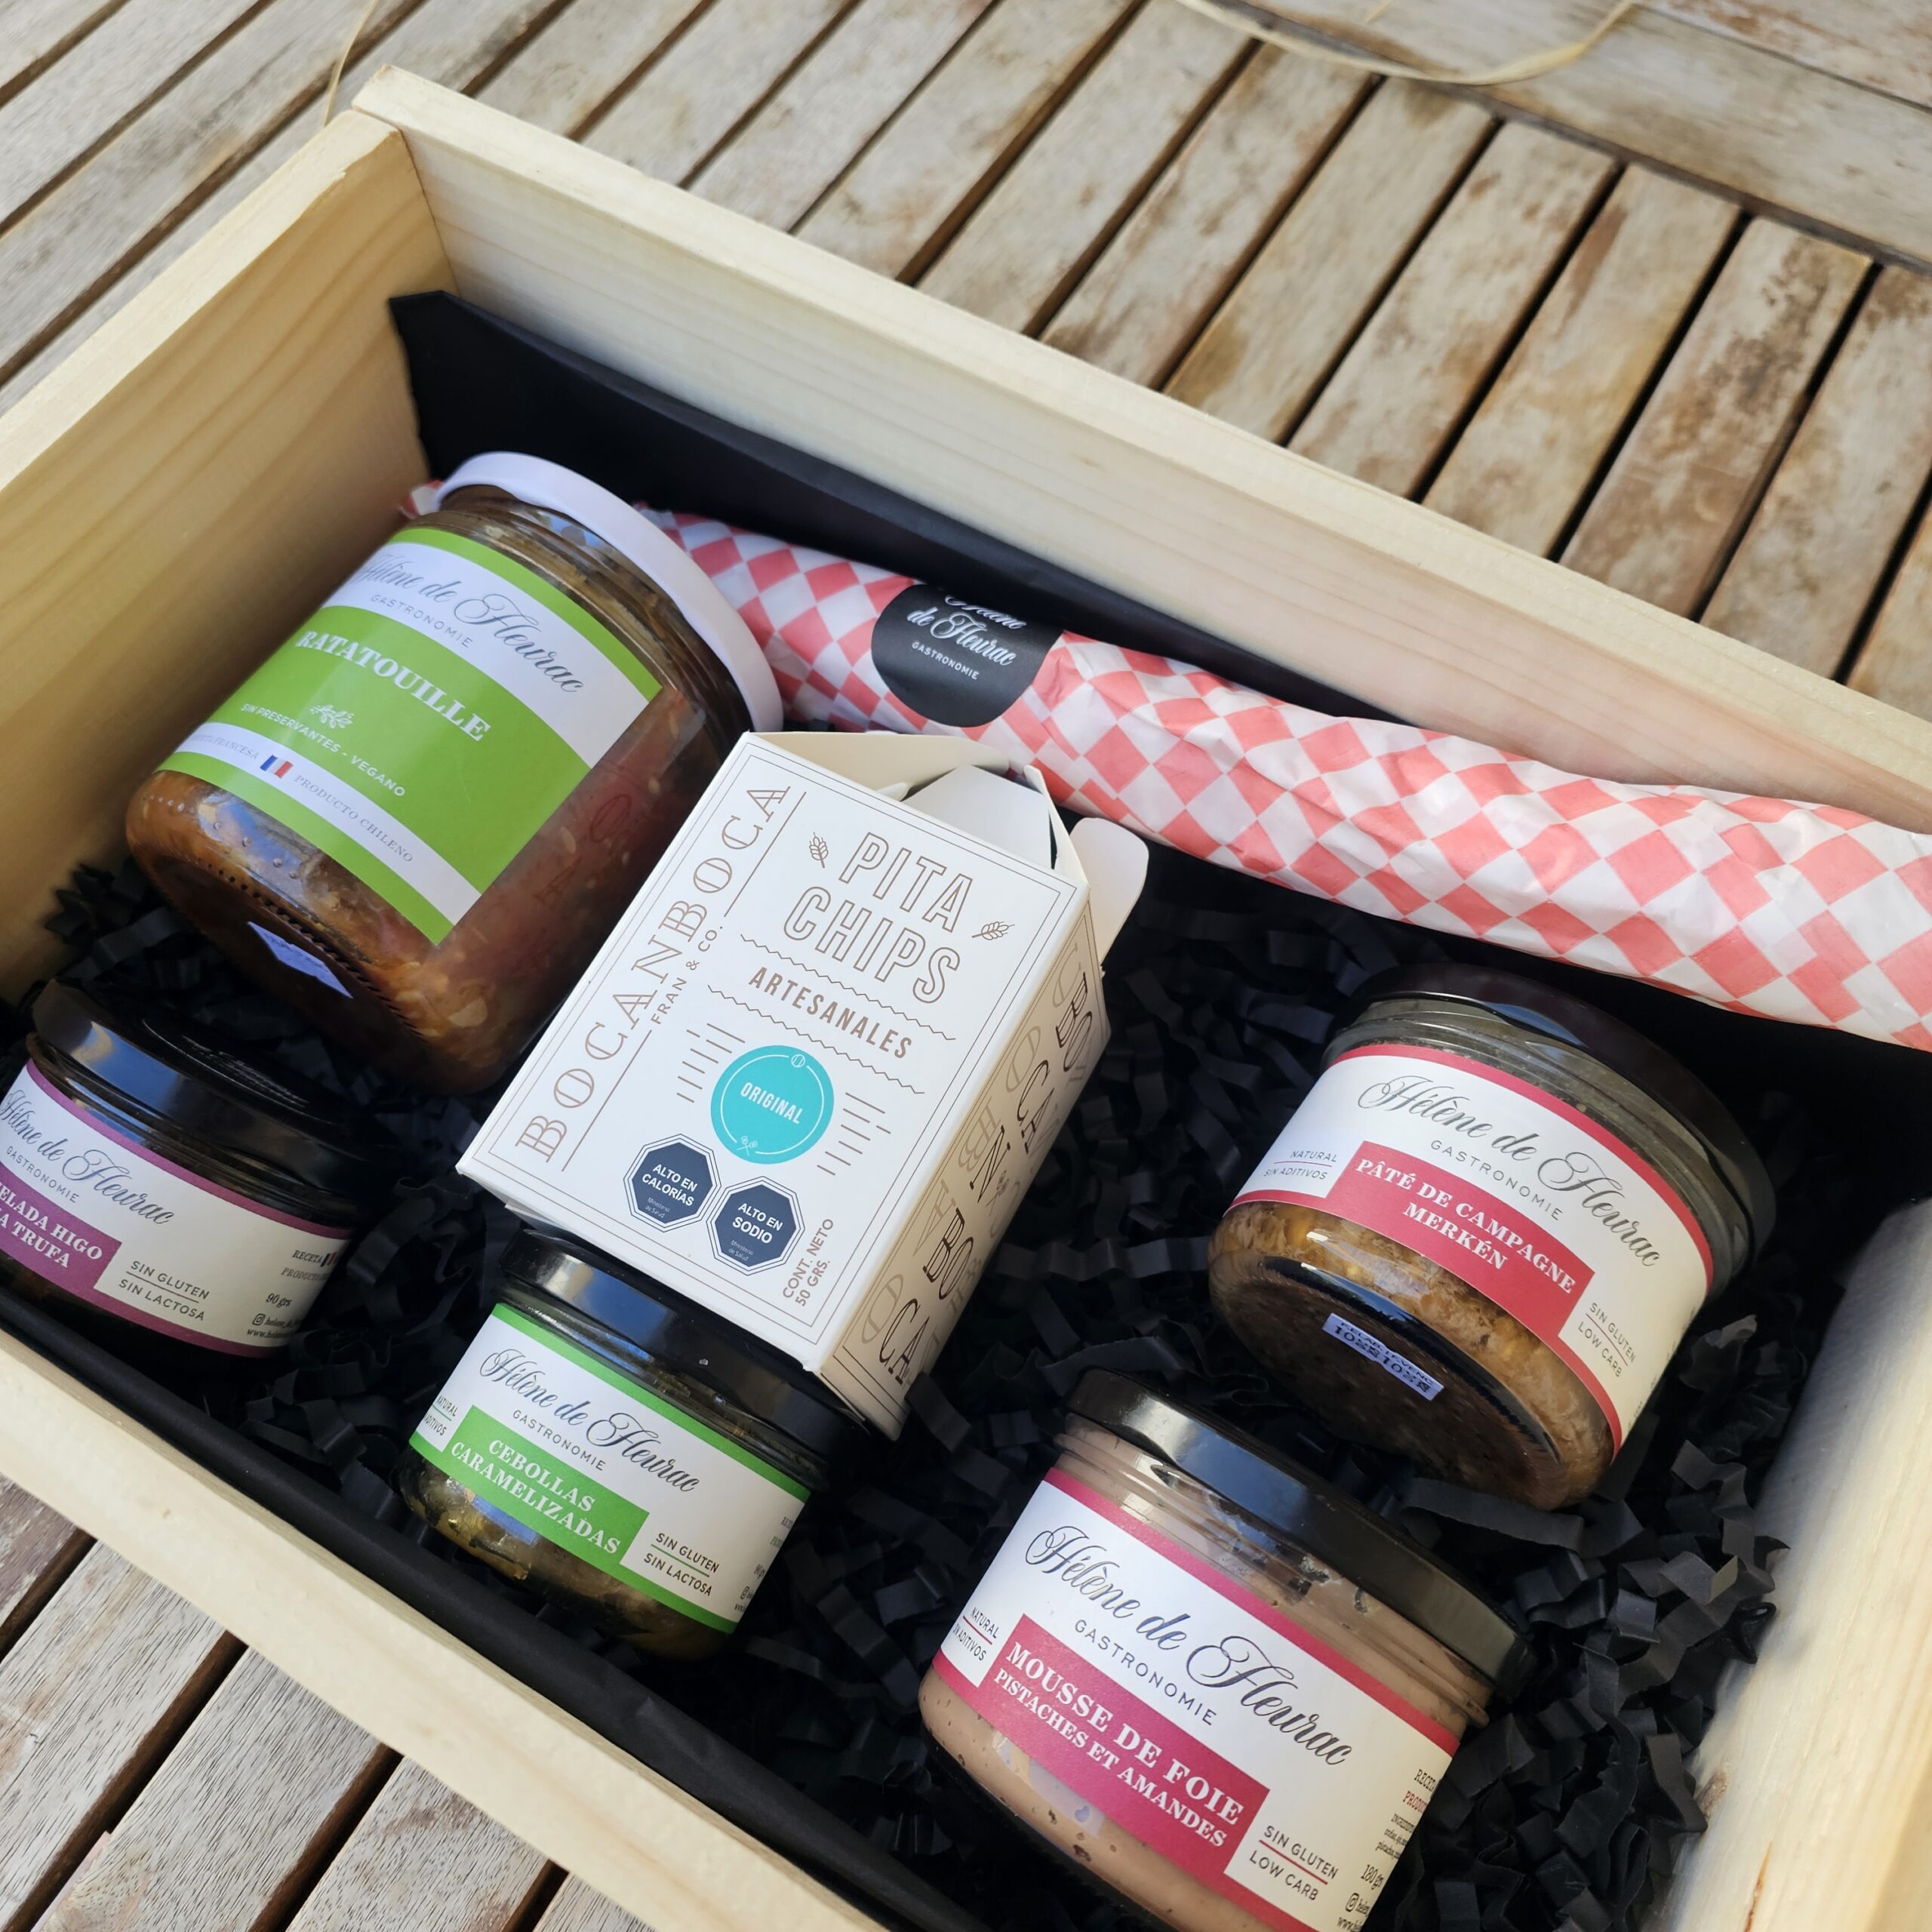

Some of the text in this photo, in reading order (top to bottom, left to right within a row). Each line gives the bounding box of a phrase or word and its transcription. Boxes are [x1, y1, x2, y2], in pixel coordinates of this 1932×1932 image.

[371, 594, 473, 648] GASTRONOMIE
[419, 580, 462, 603] de
[454, 593, 584, 693] Fleurac
[907, 606, 938, 626] de
[930, 611, 1017, 666] Fleurac
[295, 630, 492, 742] RATATOUILLE
[911, 641, 980, 680] GASTRONOMIE
[242, 703, 257, 714] SIN
[257, 706, 342, 753] PRESERVANTES
[350, 755, 405, 796] VEGANO
[294, 775, 414, 863] PRODUCTO CHILENO
[838, 832, 974, 933] PITA
[515, 785, 790, 1163] BOCANBOCA
[651, 924, 724, 1025] FRAN & CO.
[783, 887, 961, 1004] CHIPS
[748, 966, 912, 1060] ARTESANALES
[740, 1081, 804, 1124] ORIGINAL
[7, 1146, 79, 1203] GASTRONOMIE
[37, 1138, 68, 1161] de
[62, 1149, 174, 1224] Fleurac
[653, 1164, 697, 1192] ALTO EN
[1264, 1168, 1328, 1180] SIN ADITIVOS
[1291, 1150, 1337, 1163] NATURAL
[1358, 1075, 1660, 1268] Hélène de Fleurac
[1431, 1139, 1563, 1222] GASTRONOMIE
[642, 1174, 694, 1206] CALORÍAS
[738, 1203, 783, 1231] ALTO EN
[0, 1181, 103, 1260] ELADA HIGO
[11, 1220, 70, 1268] TRUFA
[732, 1217, 773, 1244] SODIO
[1354, 1158, 1575, 1295] PÂTÉ DE CAMPAGNE
[1402, 1201, 1508, 1272] MERKÉN
[130, 1260, 209, 1300] SIN GLUTEN
[292, 1250, 321, 1263] RECETA
[783, 1219, 834, 1299] CONT. NETO
[795, 1260, 831, 1307] 50 GRS.
[118, 1279, 205, 1321] SIN LACTOSA
[266, 1293, 292, 1308] 90 grs
[1578, 1321, 1622, 1377] LOW CARB
[1589, 1303, 1636, 1362] SIN GLUTEN
[479, 1348, 700, 1492] Hélène de Fleurac
[513, 1410, 605, 1471] GASTRONOMIE
[451, 1441, 621, 1555] CARAMELIZADAS
[488, 1439, 595, 1512] CEBOLLAS
[643, 1553, 712, 1597] SIN LACTOSA
[656, 1533, 720, 1574] SIN GLUTEN
[957, 1629, 986, 1660] ADITIVOS
[971, 1607, 998, 1638] NATURAL
[1026, 1526, 1352, 1767] Hélène de Fleurac
[1074, 1619, 1217, 1727] GASTRONOMIE
[994, 1671, 1229, 1849] PISTACHES ET AMANDES
[1005, 1641, 1244, 1826] MOUSSE DE FOIE
[1248, 1850, 1318, 1902] LOW CARB
[1263, 1825, 1289, 1847] SIN
[1290, 1841, 1337, 1881] GLUTEN
[1361, 1864, 1384, 1890] 180 grs
